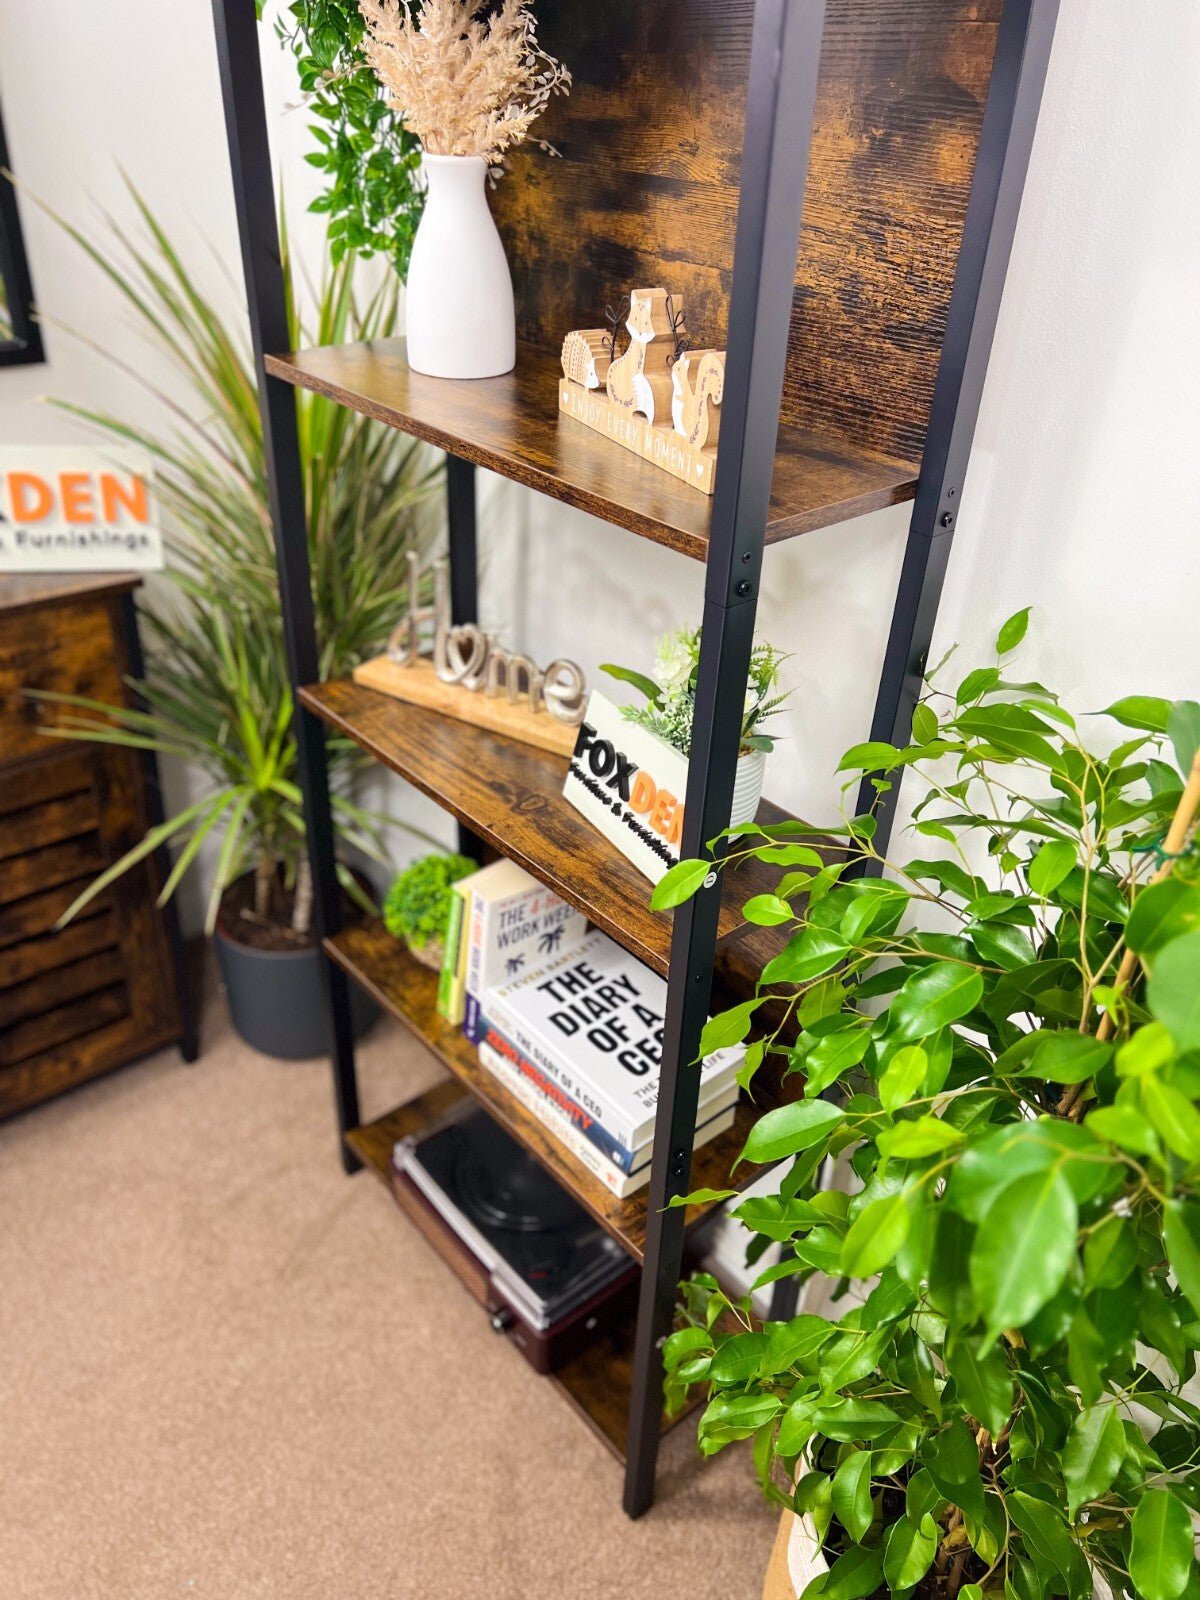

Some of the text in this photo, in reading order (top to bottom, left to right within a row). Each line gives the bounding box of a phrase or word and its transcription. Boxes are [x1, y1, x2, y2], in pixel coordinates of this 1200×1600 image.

[571, 393, 692, 476] ENJOY EVERY MOMENT
[0, 471, 150, 524] DEN
[16, 530, 149, 549] Furnishings
[500, 903, 526, 928] THE
[497, 921, 540, 949] WORK
[536, 961, 604, 1003] THE
[548, 973, 641, 1037] DIARY
[587, 1004, 665, 1053] OF A
[702, 1052, 726, 1070] LIFE
[634, 1081, 657, 1098] THE
